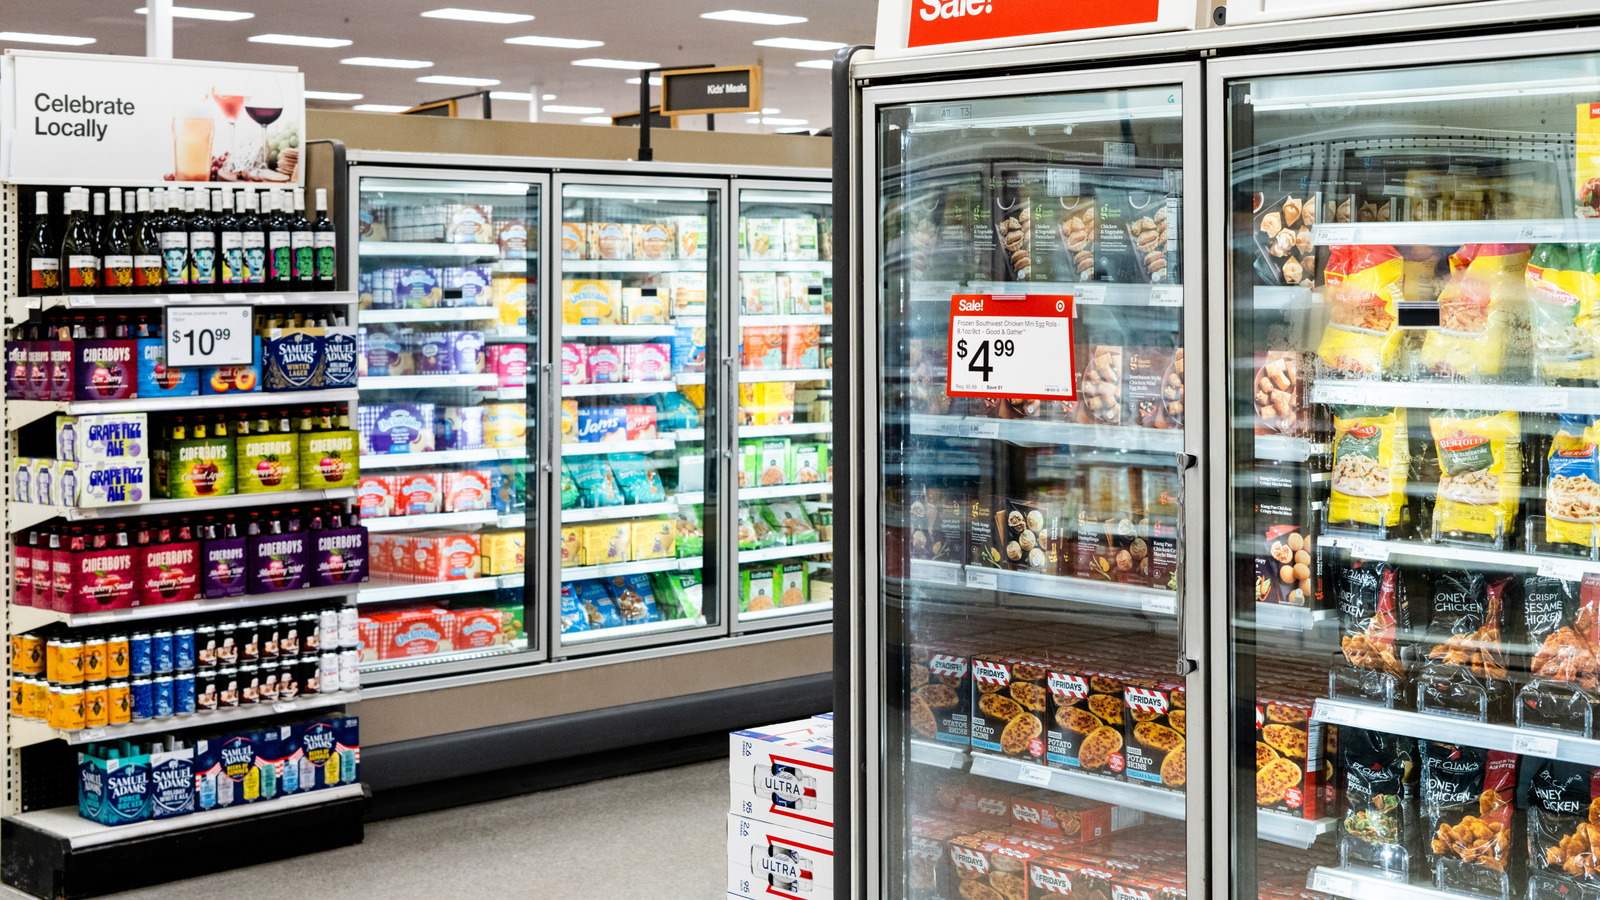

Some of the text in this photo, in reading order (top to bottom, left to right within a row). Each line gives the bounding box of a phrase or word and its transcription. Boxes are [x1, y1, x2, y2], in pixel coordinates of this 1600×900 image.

[707, 83, 747, 94] Kids' Meals
[34, 93, 135, 116] Celebrate
[35, 117, 108, 141] Locally
[958, 299, 984, 311] Sale!
[1035, 321, 1045, 329] Egg
[83, 347, 130, 362] CIDERBOYS
[279, 342, 317, 356] SAMUEL
[282, 353, 314, 364] ADAMS
[326, 352, 353, 363] ADAMS
[627, 415, 650, 430] ams
[89, 423, 141, 440] GRAPE FIZZ
[106, 441, 124, 457] ALE
[246, 441, 291, 457] CIDERBOYS
[309, 437, 352, 453] CIDERBOYS
[180, 445, 227, 461] CIDERBOYS
[90, 467, 143, 486] GRAPE FIZZ
[107, 485, 126, 502] ALE
[258, 540, 302, 557] CIDERBOYS
[318, 534, 362, 551] CIDERBOYS
[147, 549, 193, 567] CIDERBOYS
[209, 548, 243, 561] CIDERBOYS
[82, 555, 131, 573] CIDERBOYS
[1529, 593, 1558, 601] CRISPY
[1435, 602, 1483, 613] CHICKEN
[1525, 601, 1563, 613] SESAME
[980, 668, 1005, 680] FRIDAYS
[1055, 681, 1082, 692] FRIDAYS
[1133, 694, 1162, 707] FRIDAYS
[303, 731, 335, 746] SAMUEL
[1047, 738, 1072, 749] POTATO
[221, 745, 254, 760] SAMUEL
[306, 741, 332, 751] ADAMS
[1047, 745, 1066, 755] SKINS
[224, 753, 251, 766] ADAMS
[1127, 754, 1153, 766] POTATO
[1127, 762, 1147, 771] SKINS
[108, 772, 149, 790] SAMUEL
[152, 767, 193, 783] SAMUEL
[112, 783, 146, 799] ADAMS
[157, 779, 191, 793] ADAMS
[765, 777, 800, 795] ULTRA
[745, 801, 752, 814] 95
[958, 853, 983, 866] FRIDAYS
[762, 858, 796, 878] ULTRA
[743, 880, 750, 893] 95
[1039, 876, 1067, 888] FRIDAYS
